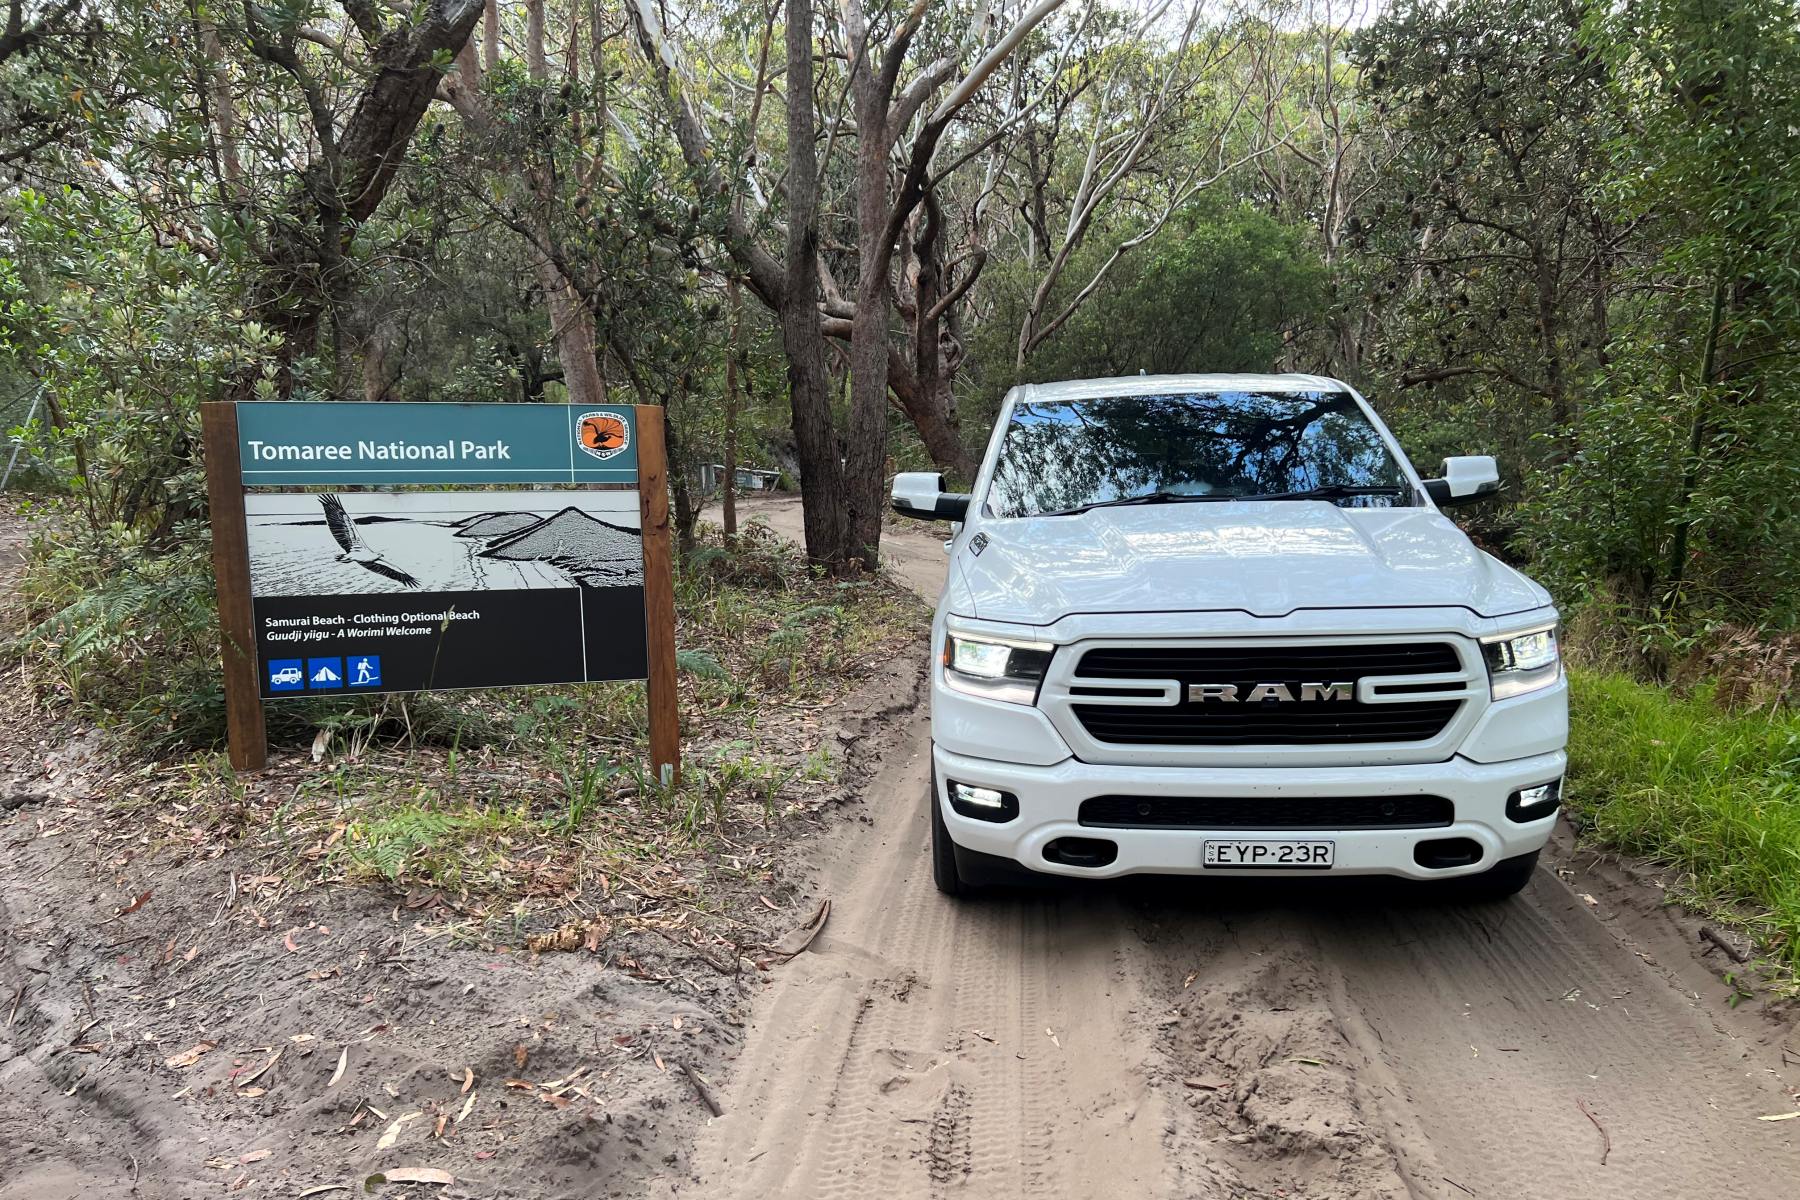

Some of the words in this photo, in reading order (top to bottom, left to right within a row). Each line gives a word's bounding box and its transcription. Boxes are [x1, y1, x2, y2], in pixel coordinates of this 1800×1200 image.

[248, 440, 352, 460] Tomaree
[358, 440, 455, 460] National
[461, 440, 511, 460] Park
[265, 616, 310, 627] Samurai
[312, 615, 345, 626] Beach
[353, 613, 399, 625] Clothing
[401, 611, 447, 624] Optional
[449, 610, 480, 620] Beach
[266, 630, 302, 642] Guudji
[303, 630, 329, 642] yiigu
[337, 628, 345, 638] A
[347, 627, 384, 638] Worimi
[386, 626, 432, 636] Welcome
[1188, 682, 1354, 702] RAM
